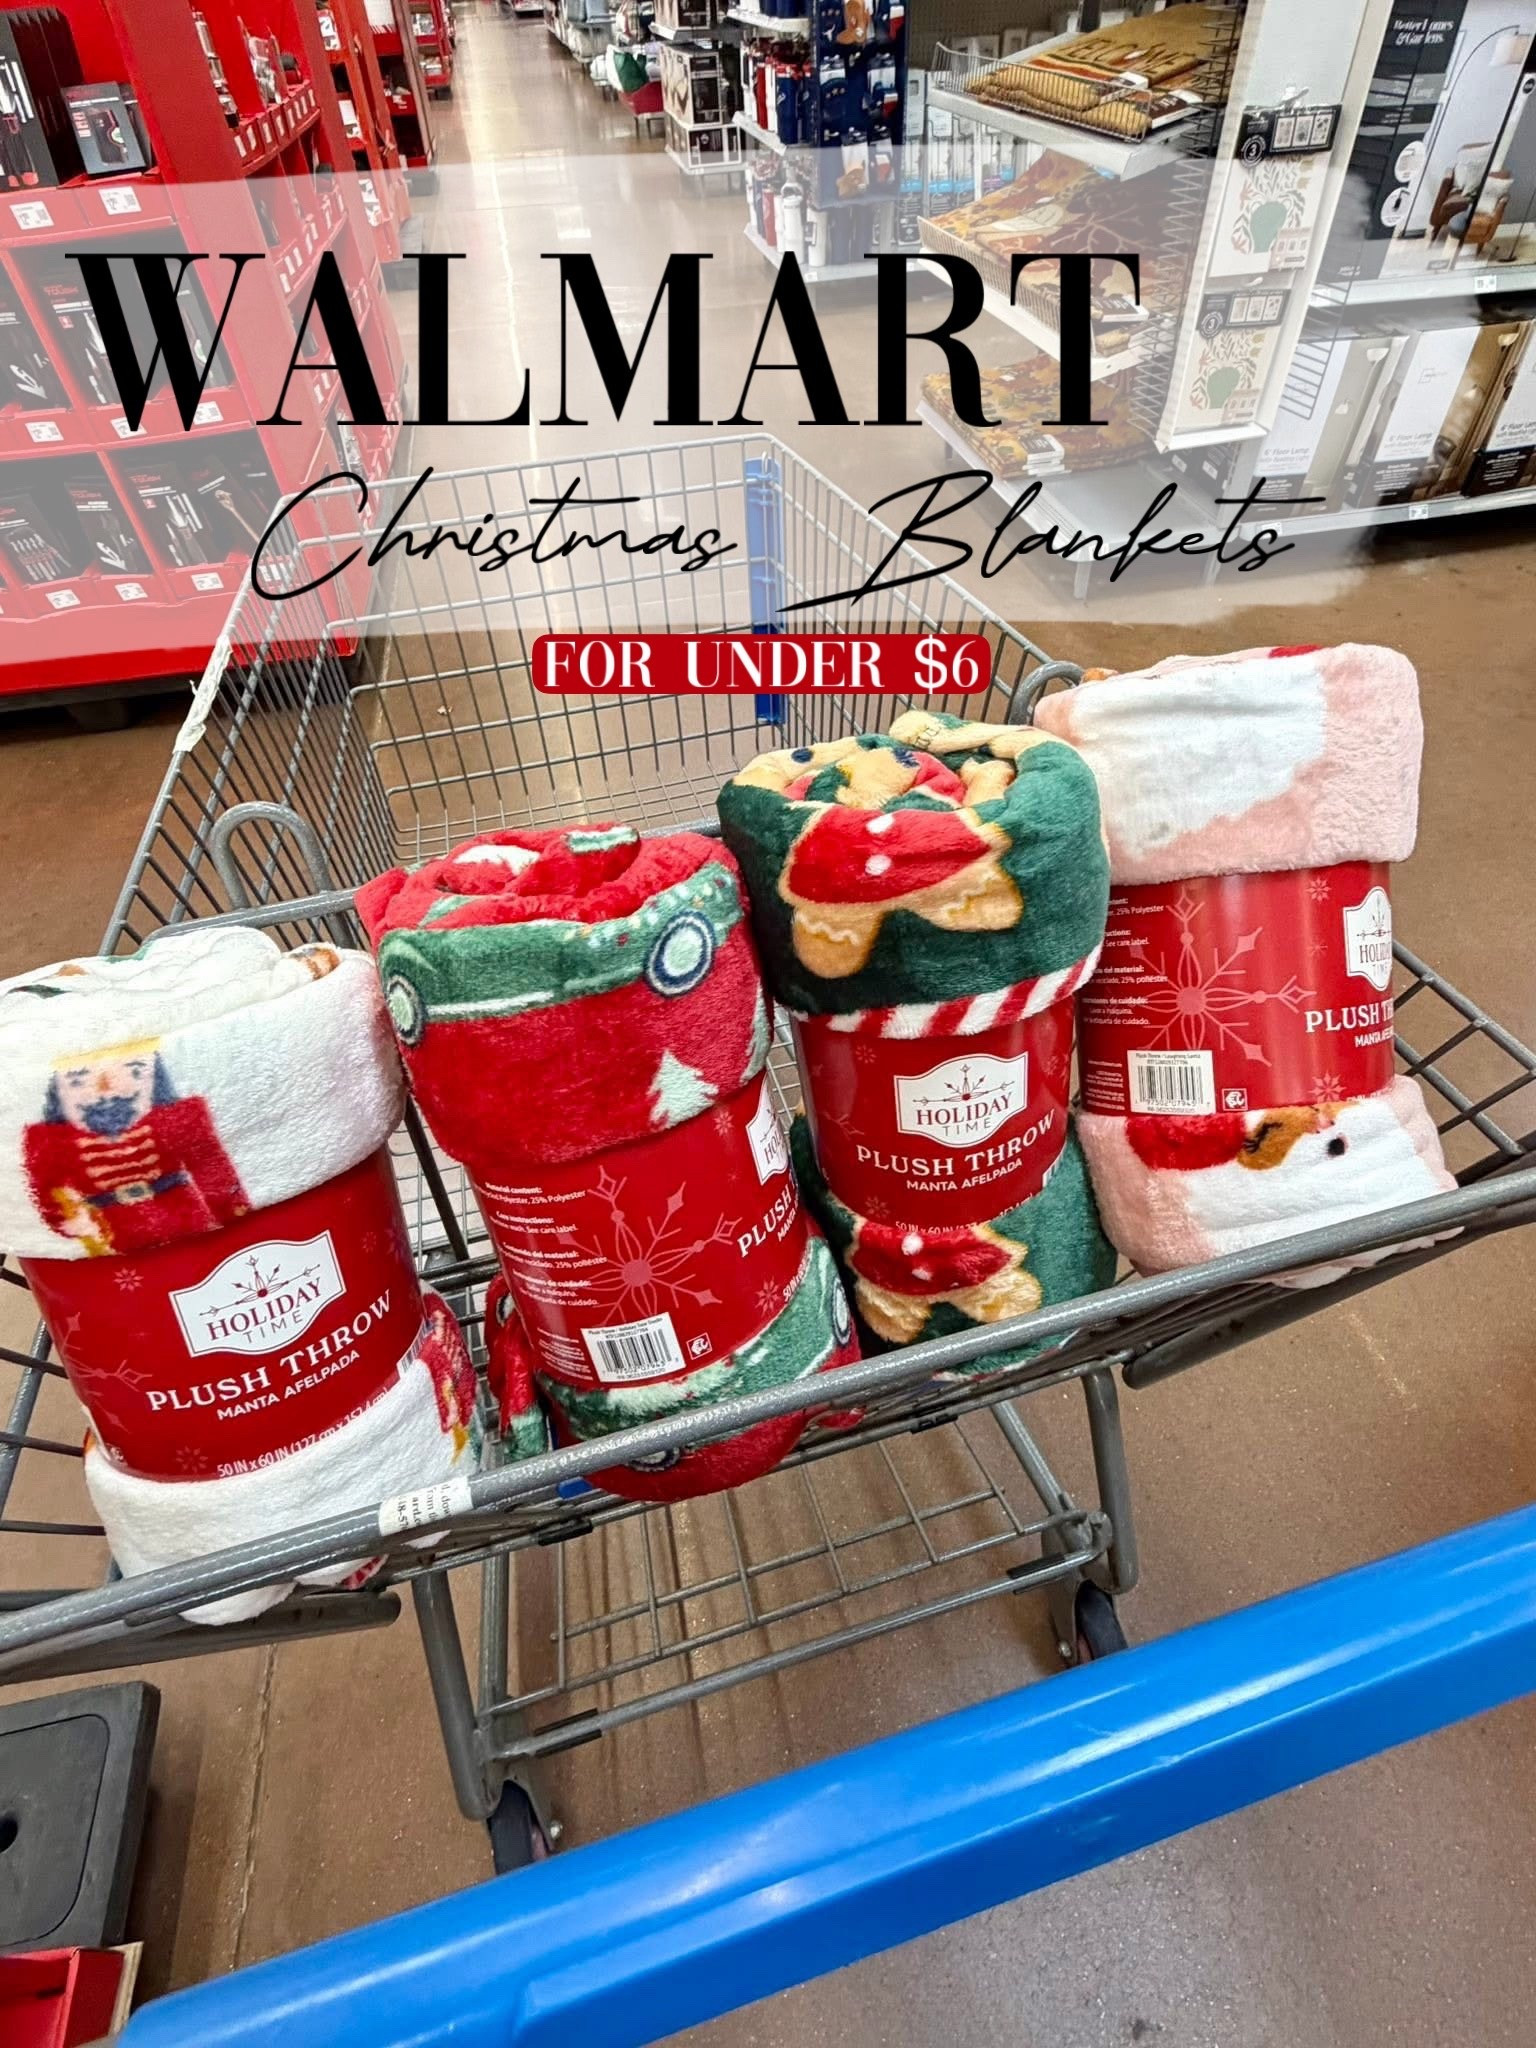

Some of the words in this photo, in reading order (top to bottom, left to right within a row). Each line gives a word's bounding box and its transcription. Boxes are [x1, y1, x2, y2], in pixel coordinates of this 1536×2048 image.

[1305, 1002, 1380, 1033] PLUSH
[916, 1092, 1013, 1126] HOLIDAY
[856, 1144, 954, 1176] PLUSH
[964, 1108, 1055, 1172] THROW
[943, 1117, 992, 1137] TIME
[906, 1180, 958, 1191] MANTA
[961, 1158, 1023, 1190] AFELPADA
[547, 1190, 586, 1204] Polyester
[540, 1226, 556, 1234] care
[556, 1223, 579, 1233] label.
[737, 1184, 792, 1258] PLUSH
[206, 1277, 323, 1341] HOLIDAY
[243, 1309, 304, 1344] TIME
[146, 1366, 271, 1411] PLUSH
[280, 1289, 392, 1376] THROW
[216, 1391, 280, 1421] MANTA
[284, 1350, 360, 1400] AFELPADA
[217, 1463, 234, 1478] 50
[234, 1459, 249, 1473] IN
[249, 1461, 258, 1471] x
[257, 1451, 274, 1468] 60
[274, 1446, 290, 1462] IN
